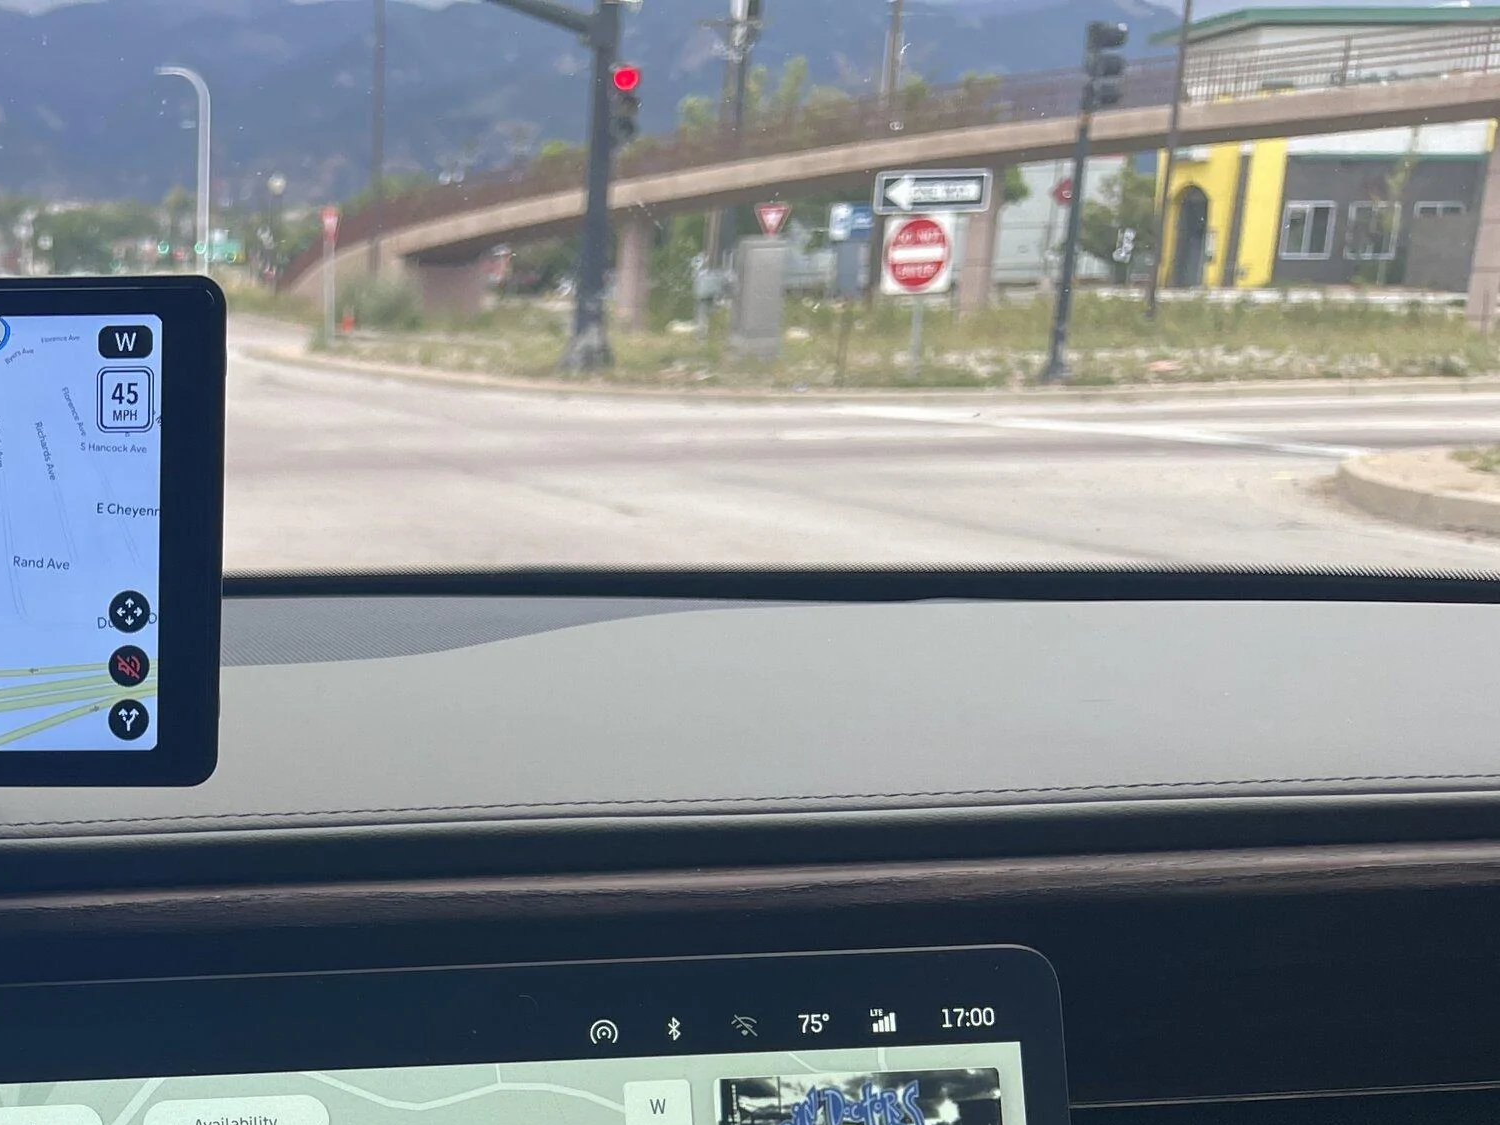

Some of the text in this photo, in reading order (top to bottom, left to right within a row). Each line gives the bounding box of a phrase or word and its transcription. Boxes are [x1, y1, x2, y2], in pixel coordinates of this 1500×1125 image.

[114, 332, 137, 352] W
[111, 383, 139, 405] 45
[62, 387, 87, 437] Florence Ave
[112, 409, 138, 421] MPH
[35, 421, 56, 480] Richards Ave
[80, 442, 148, 454] S Hancock Ave
[97, 502, 104, 514] E
[13, 556, 70, 571] Rand Ave
[870, 1009, 883, 1017] LTE
[941, 1008, 995, 1028] 17:00
[650, 1099, 666, 1115] W
